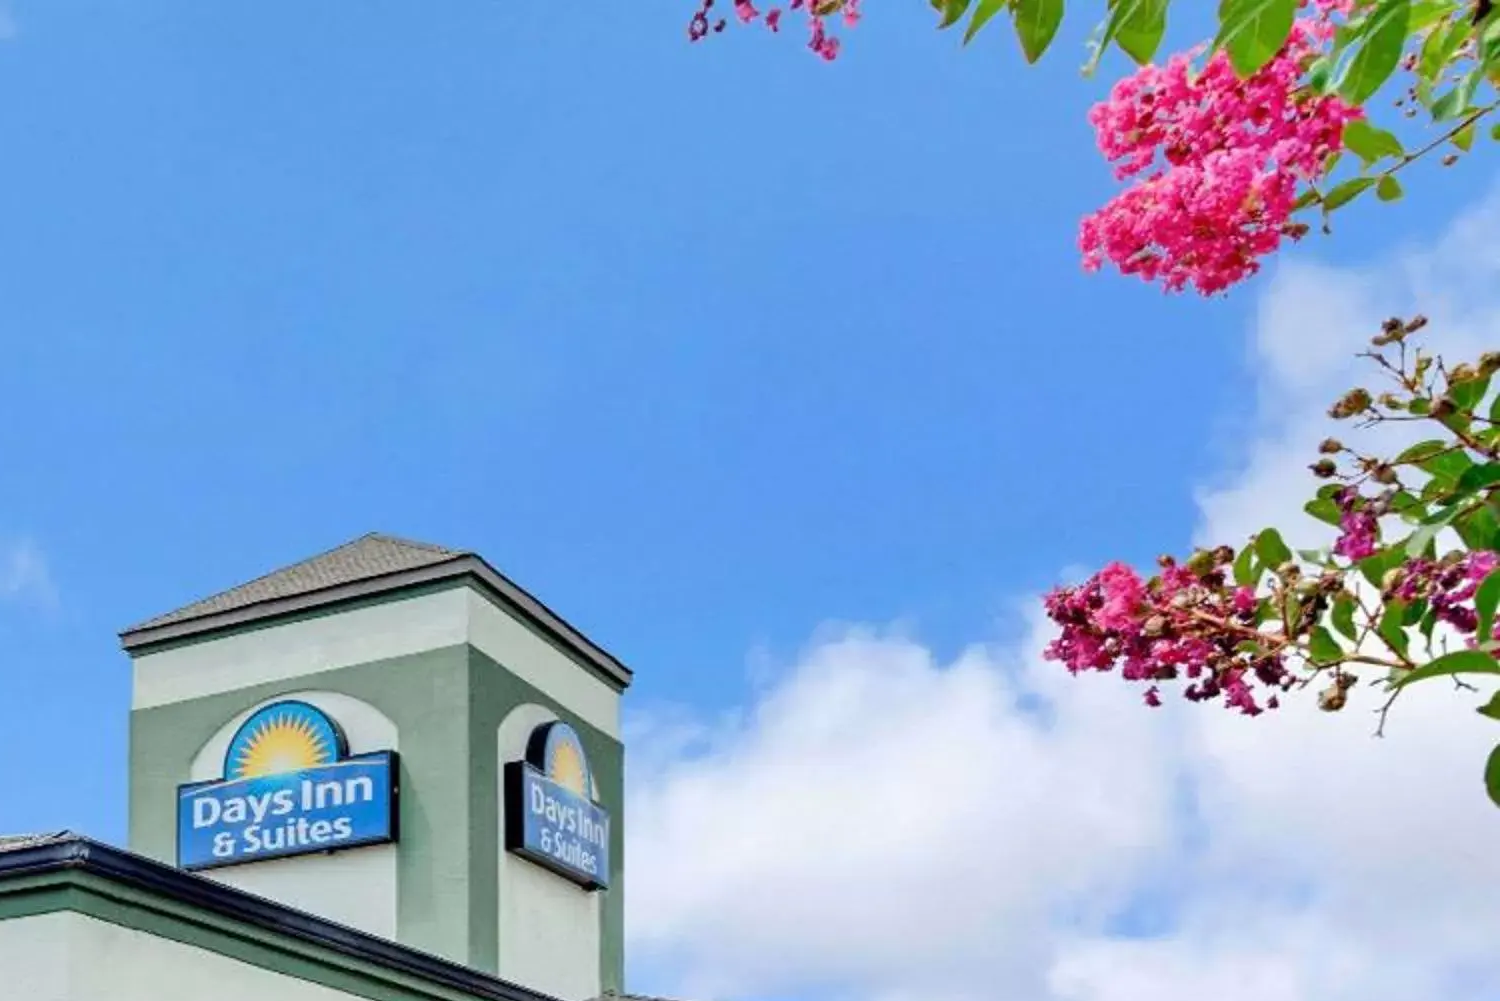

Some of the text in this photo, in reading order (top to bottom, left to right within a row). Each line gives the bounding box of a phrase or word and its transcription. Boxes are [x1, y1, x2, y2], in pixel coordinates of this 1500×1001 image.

[193, 775, 373, 829] Days Inn
[531, 782, 605, 849] Days Inn
[212, 816, 352, 858] & Suites
[540, 828, 598, 874] & Suites
